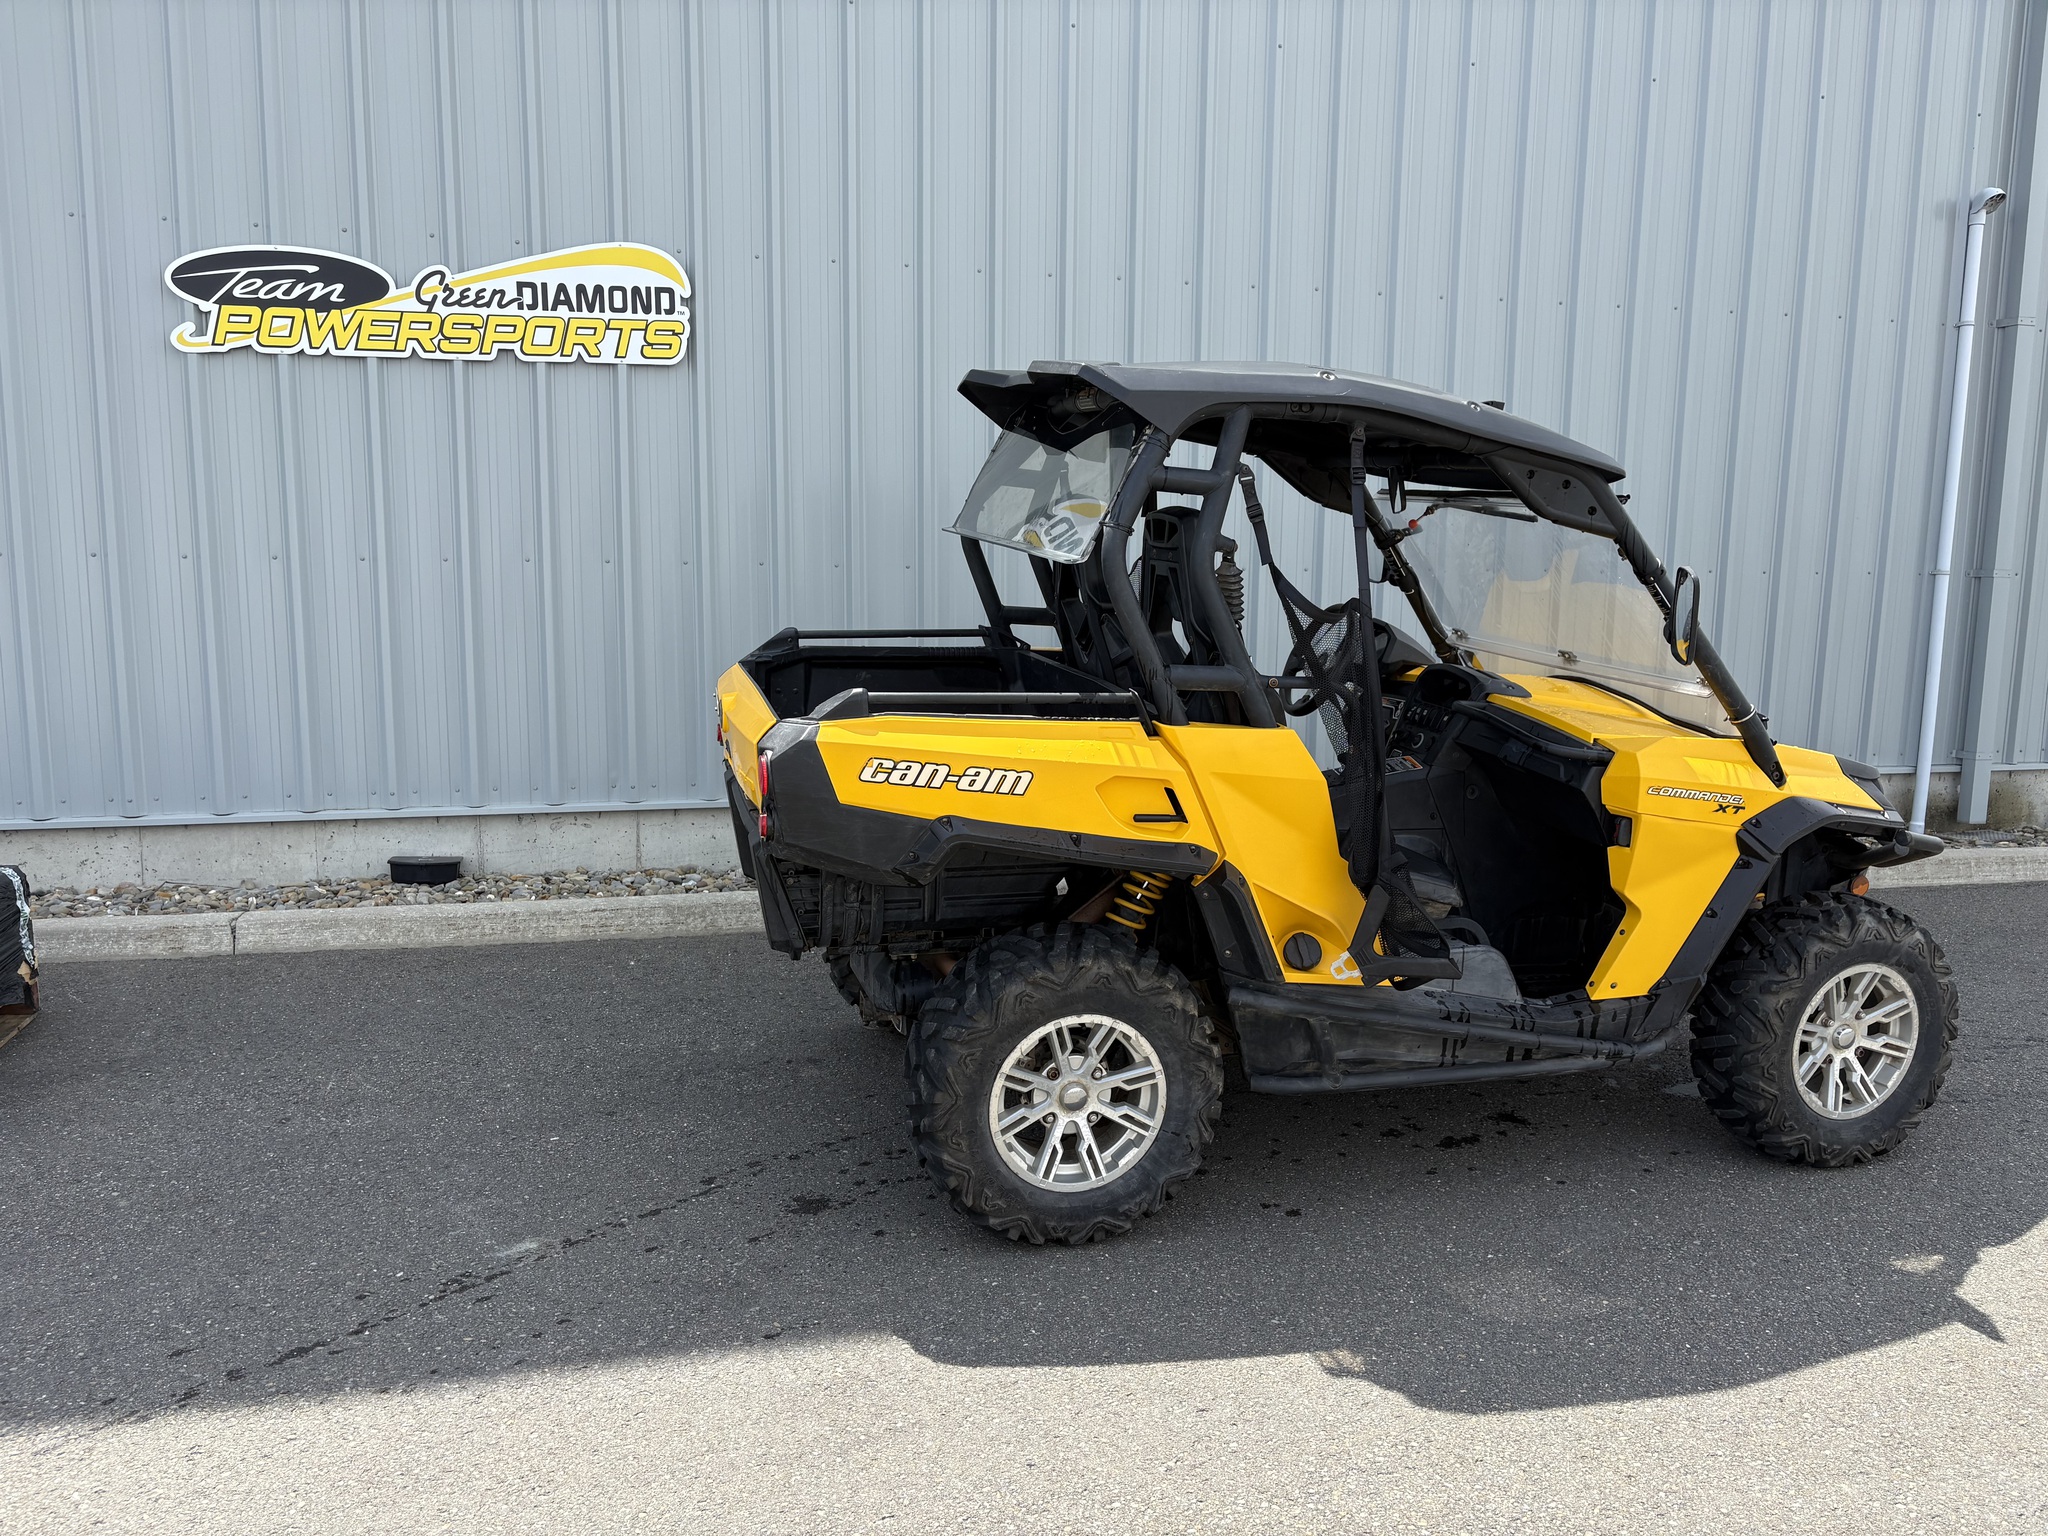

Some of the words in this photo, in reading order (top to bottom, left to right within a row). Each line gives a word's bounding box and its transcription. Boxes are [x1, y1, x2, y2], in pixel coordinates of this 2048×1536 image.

[172, 264, 346, 303] Team
[415, 270, 522, 313] Green
[516, 281, 676, 315] DIAMOND
[211, 304, 685, 359] POWERSPORTS
[858, 757, 1034, 796] can-am
[1647, 786, 1744, 805] COMMANDE
[1712, 803, 1746, 815] XT
